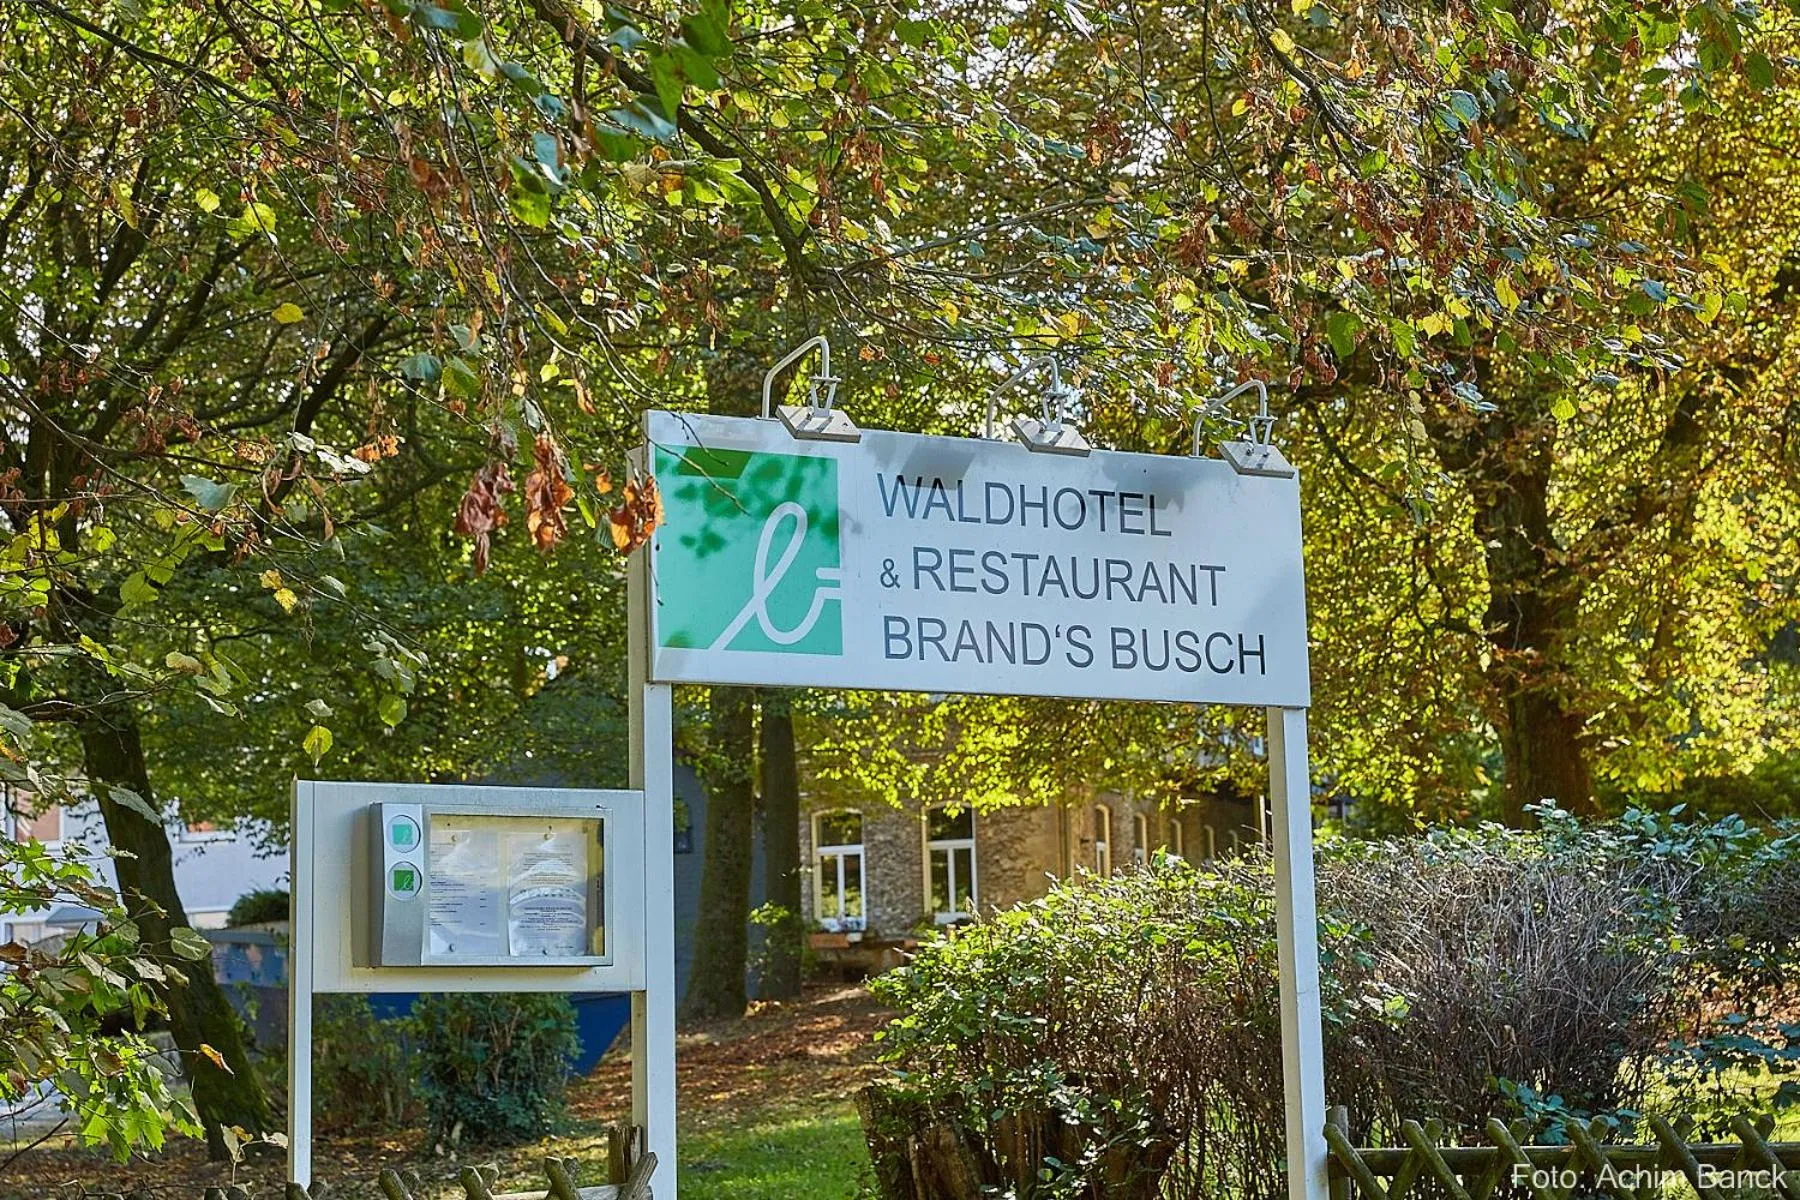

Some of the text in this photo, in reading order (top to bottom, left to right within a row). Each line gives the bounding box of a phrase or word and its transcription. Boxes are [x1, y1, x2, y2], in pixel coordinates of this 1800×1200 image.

[877, 472, 1172, 537] WALDHOTEL
[880, 546, 1226, 606] & RESTAURANT
[1111, 627, 1267, 675] BUSCH
